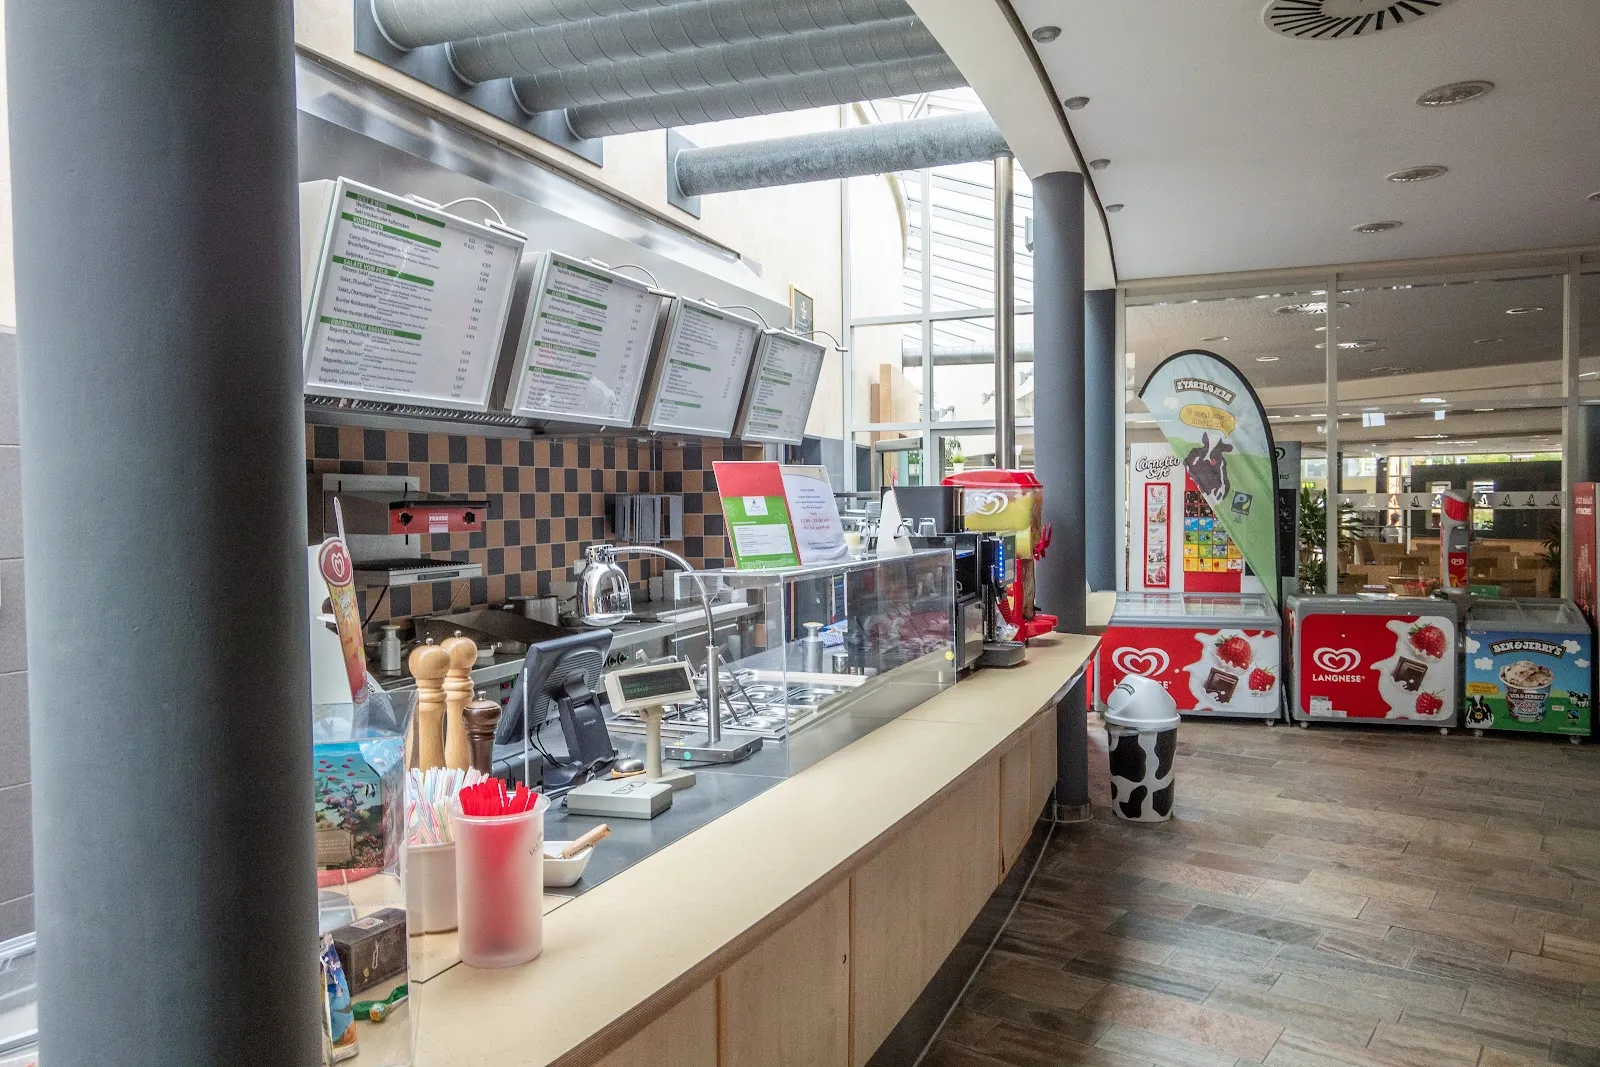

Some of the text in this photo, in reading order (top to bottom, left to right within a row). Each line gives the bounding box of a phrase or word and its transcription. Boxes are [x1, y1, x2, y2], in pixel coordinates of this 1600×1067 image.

[351, 223, 370, 233] Tomaten-
[352, 216, 383, 230] VORSPEISEN
[347, 240, 369, 250] Bruschetta
[344, 250, 363, 260] Soljanka
[342, 258, 388, 274] SALATE VOM FELD
[367, 325, 395, 335] BAGUETTES
[1135, 456, 1181, 472] Cornetto
[1145, 468, 1171, 480] Soft
[1493, 641, 1562, 656] BEN&JERRY'S
[1312, 674, 1361, 683] LANGNESE
